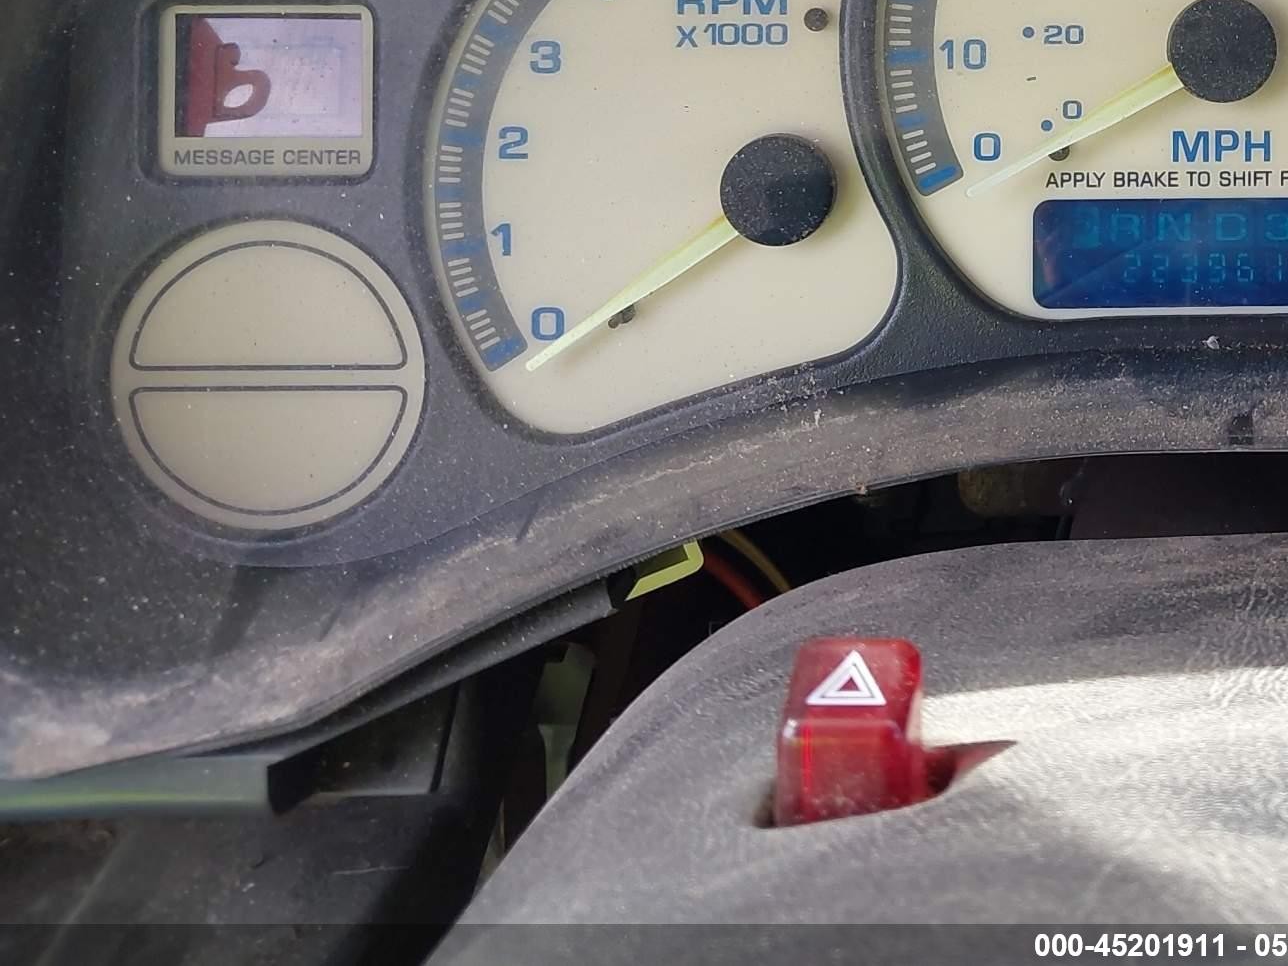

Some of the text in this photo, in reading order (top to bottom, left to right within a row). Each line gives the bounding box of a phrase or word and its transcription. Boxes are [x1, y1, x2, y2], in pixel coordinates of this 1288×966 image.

[1044, 25, 1084, 44] 20
[530, 41, 561, 74] 3
[940, 40, 986, 69] 10
[1063, 101, 1082, 119] 0
[174, 150, 361, 164] MESSAGE CENTER
[499, 127, 528, 159] 2
[974, 133, 1000, 161] 0
[1173, 130, 1270, 162] MPH
[1046, 172, 1105, 188] APPLY
[1114, 172, 1178, 187] BRAKE
[1186, 171, 1210, 187] TO
[1220, 171, 1272, 186] SHIFT
[491, 223, 511, 256] 1
[532, 307, 564, 340] 0
